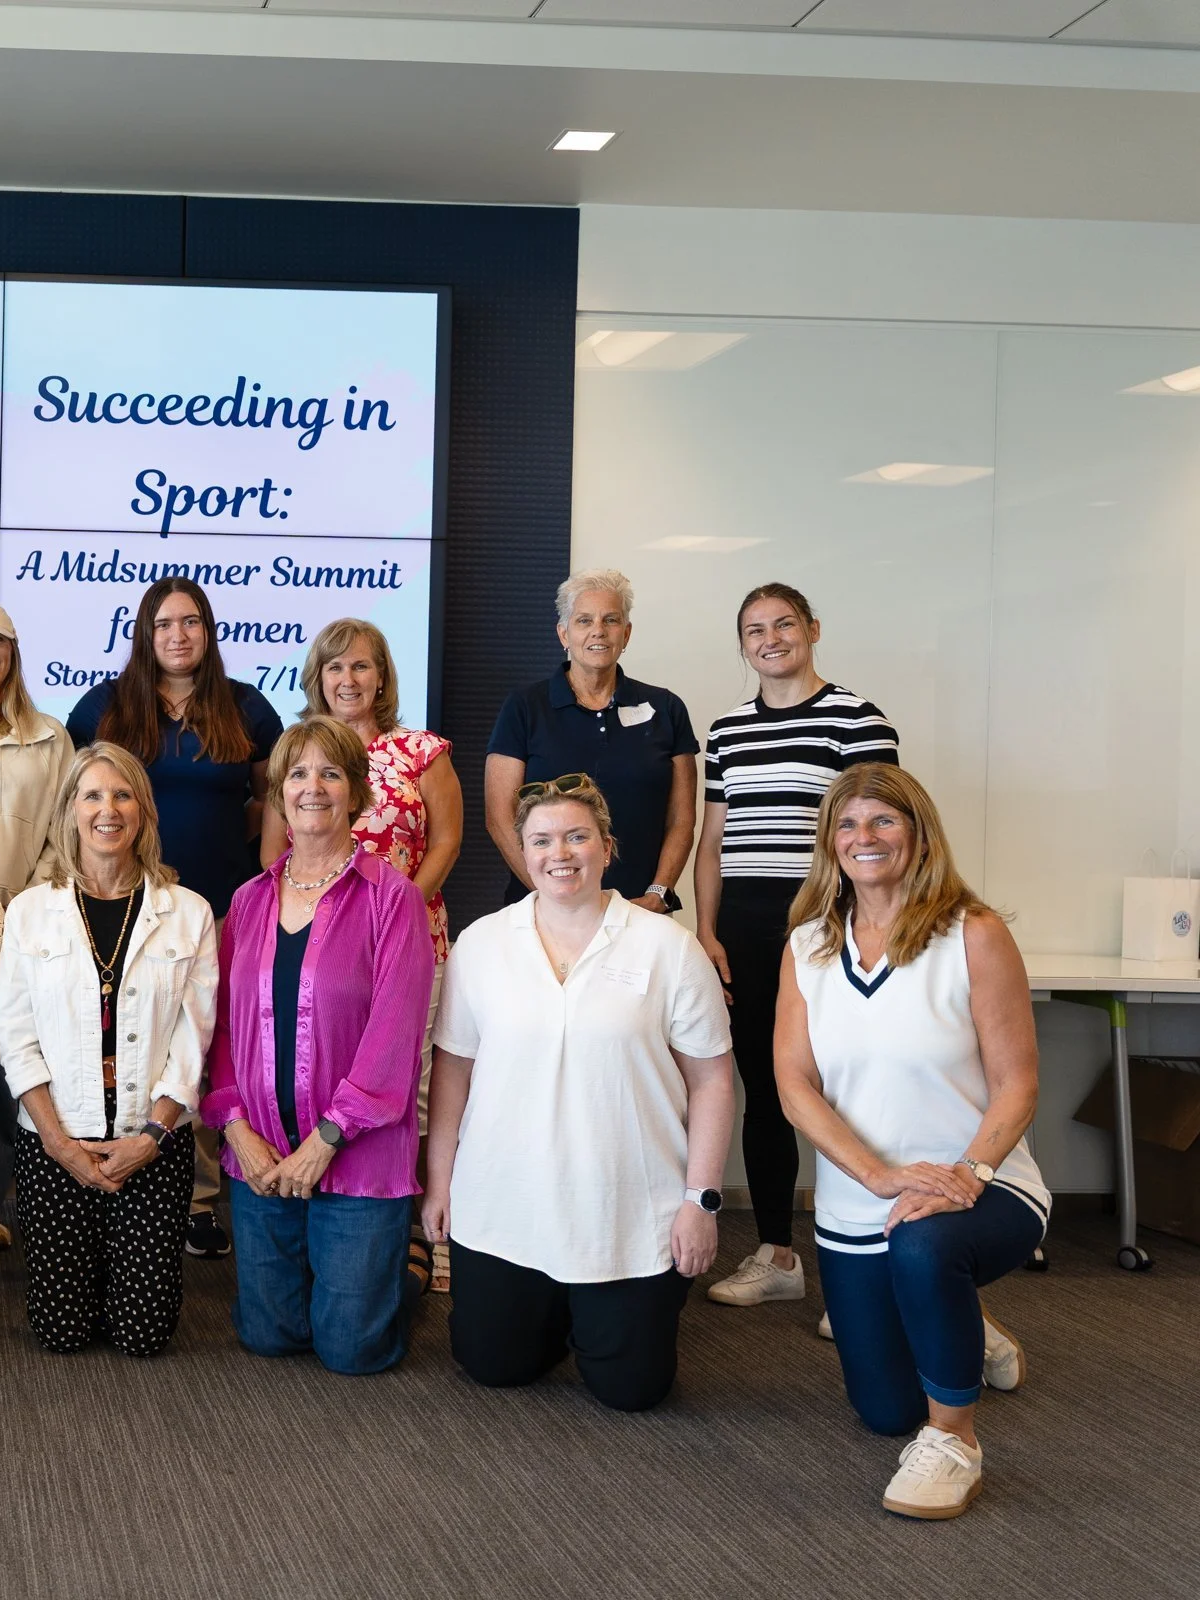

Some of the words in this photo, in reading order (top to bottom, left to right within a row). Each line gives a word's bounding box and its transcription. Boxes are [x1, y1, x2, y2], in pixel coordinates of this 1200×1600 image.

[34, 375, 334, 450] Succeeding
[343, 385, 396, 431] in
[131, 469, 292, 538] Sport:
[16, 550, 45, 580] A
[50, 549, 261, 586] Midsummer
[270, 556, 402, 589] Summit
[103, 606, 137, 653] fo
[215, 621, 307, 643] omen
[44, 661, 119, 687] Storr
[256, 665, 303, 691] 7/1
